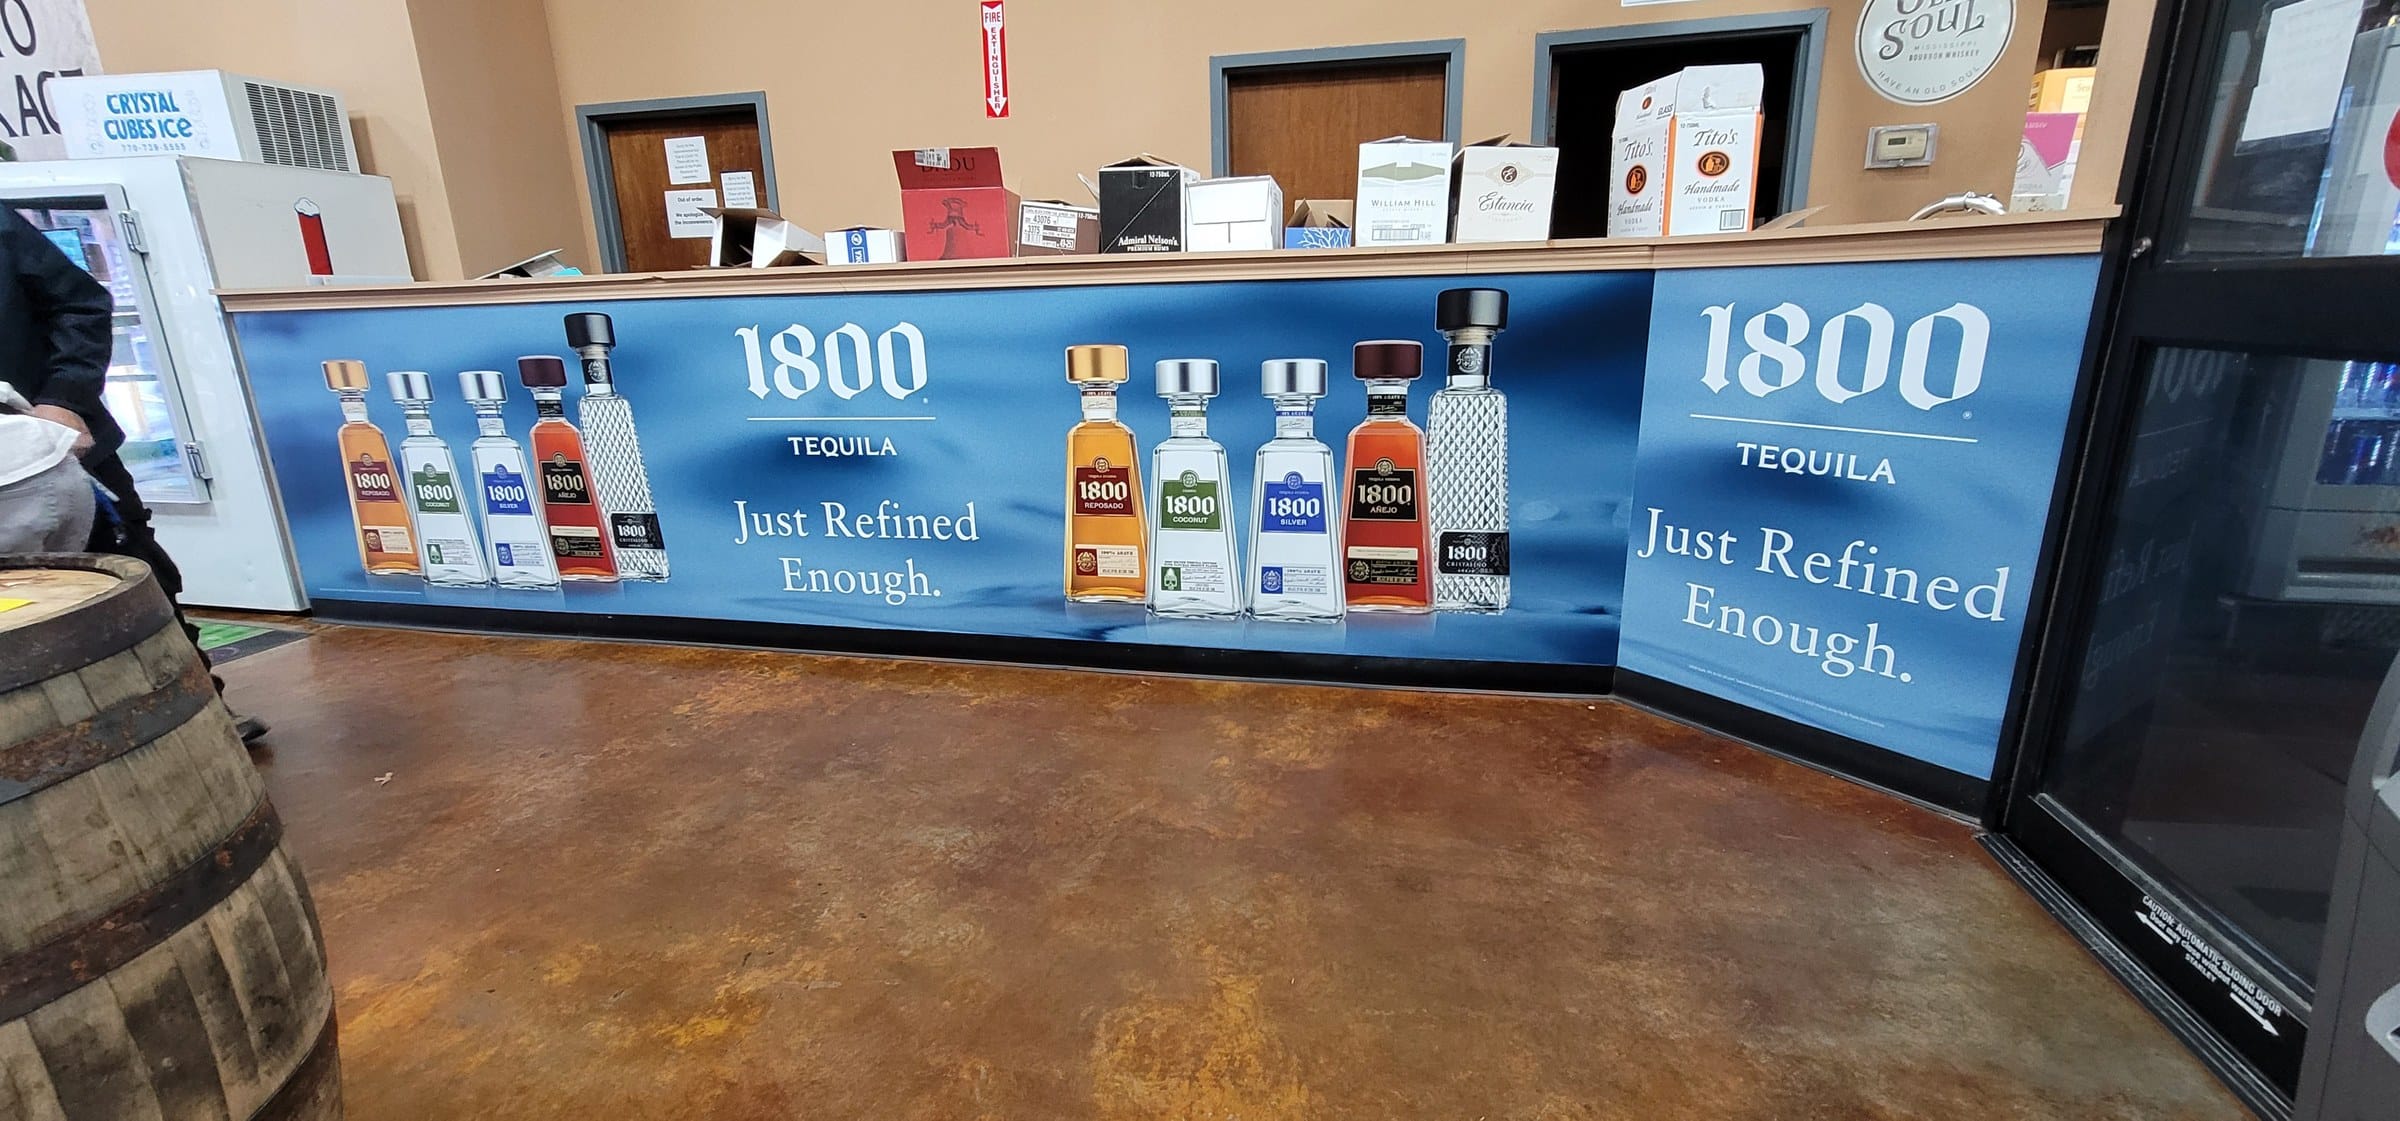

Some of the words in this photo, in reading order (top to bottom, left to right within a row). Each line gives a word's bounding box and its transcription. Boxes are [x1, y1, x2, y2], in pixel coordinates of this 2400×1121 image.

[984, 11, 1001, 23] FIRE
[0, 0, 36, 57] O
[1879, 1, 1984, 60] SOUL
[1914, 41, 1977, 50] MISSISSIPPI
[1908, 52, 1943, 62] BOURBON
[1945, 50, 1980, 59] WHISKEY
[990, 26, 1001, 109] EXTINGUISHER
[1878, 71, 1903, 90] HAVE
[1905, 87, 1920, 95] AN
[1924, 84, 1946, 95] OLD
[1952, 66, 1981, 86] SOUL
[106, 90, 180, 114] CRYSTAL
[103, 118, 156, 140] CUBES
[1693, 128, 1738, 146] Tito's
[1624, 136, 1653, 161] Tito's
[1684, 178, 1740, 195] Handmade
[1371, 199, 1411, 207] WILLIAM
[1414, 199, 1436, 207] HILL
[1478, 191, 1535, 213] Estancia
[1118, 234, 1147, 246] Admiral
[734, 321, 928, 400] 1800
[1700, 301, 1991, 411] 1800
[787, 436, 898, 457] TEQUILA
[1736, 442, 1897, 485] TEQUILA
[353, 472, 391, 489] 1800
[545, 474, 584, 491] 1800
[416, 484, 453, 501] 1800
[487, 485, 525, 502] 1800
[1078, 481, 1128, 501] 1800
[1358, 484, 1412, 504] 1800
[1084, 502, 1124, 510] REPOSADO
[1165, 495, 1215, 515] 1800
[1268, 496, 1320, 518] 1800
[1370, 506, 1398, 514] AÑEJO
[733, 500, 809, 545] Just
[820, 499, 980, 542] Refined
[1172, 516, 1208, 524] COCONUT
[1280, 518, 1307, 526] SILVER
[617, 525, 646, 537] 1800
[1447, 545, 1487, 561] 1800
[1637, 507, 1738, 565] Just
[1755, 527, 2010, 622] Refined
[779, 557, 942, 605] Enough.
[1682, 582, 1913, 684] Enough.
[2142, 895, 2175, 928] CAUTION:
[2175, 923, 2222, 967] AUTOMATIC
[2220, 960, 2255, 994] SLIDING
[2255, 987, 2282, 1017] DOOR
[2150, 911, 2166, 928] Door
[2166, 926, 2181, 943] may
[2181, 938, 2201, 959] close
[2201, 954, 2231, 985] without
[2230, 982, 2265, 1016] warning
[2184, 953, 2217, 983] STANLEY
